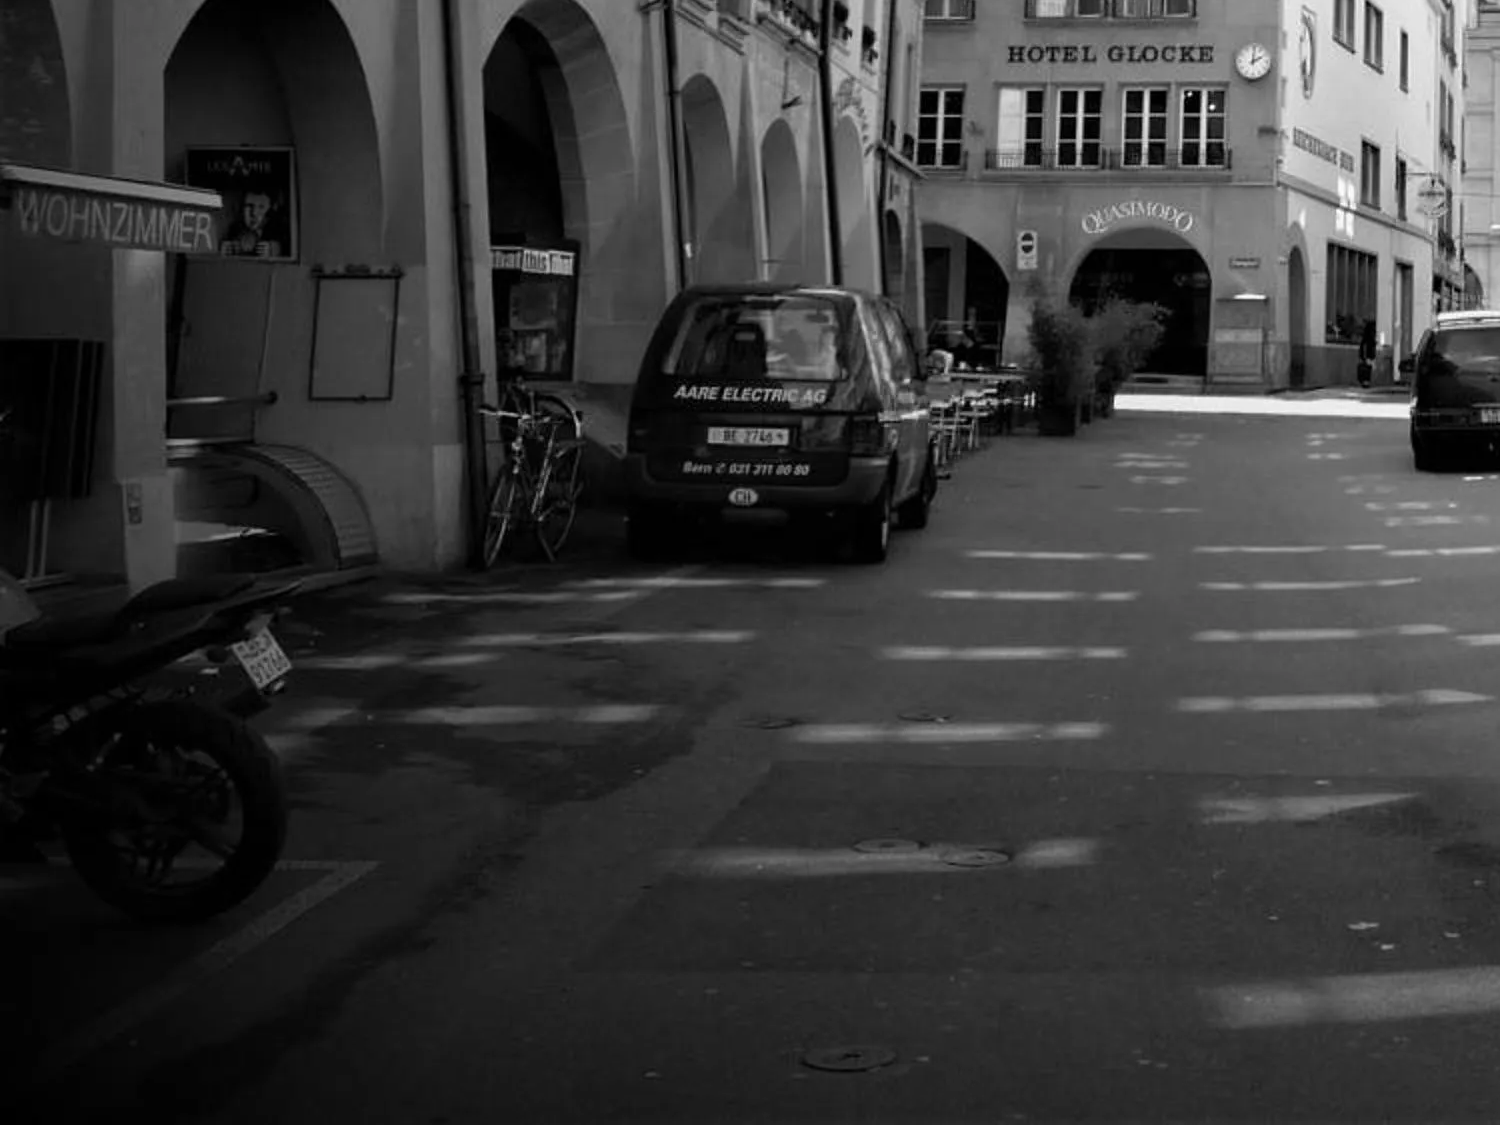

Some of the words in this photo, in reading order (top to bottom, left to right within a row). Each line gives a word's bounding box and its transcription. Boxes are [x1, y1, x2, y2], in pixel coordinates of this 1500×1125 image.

[1007, 45, 1097, 64] HOTEL
[1107, 45, 1214, 64] GLOCKE
[16, 187, 213, 252] WOHNZIMMER
[1081, 201, 1194, 234] QUASIMODO
[673, 383, 720, 401] AARE
[721, 386, 799, 403] ELECTRIC
[802, 387, 828, 405] AG
